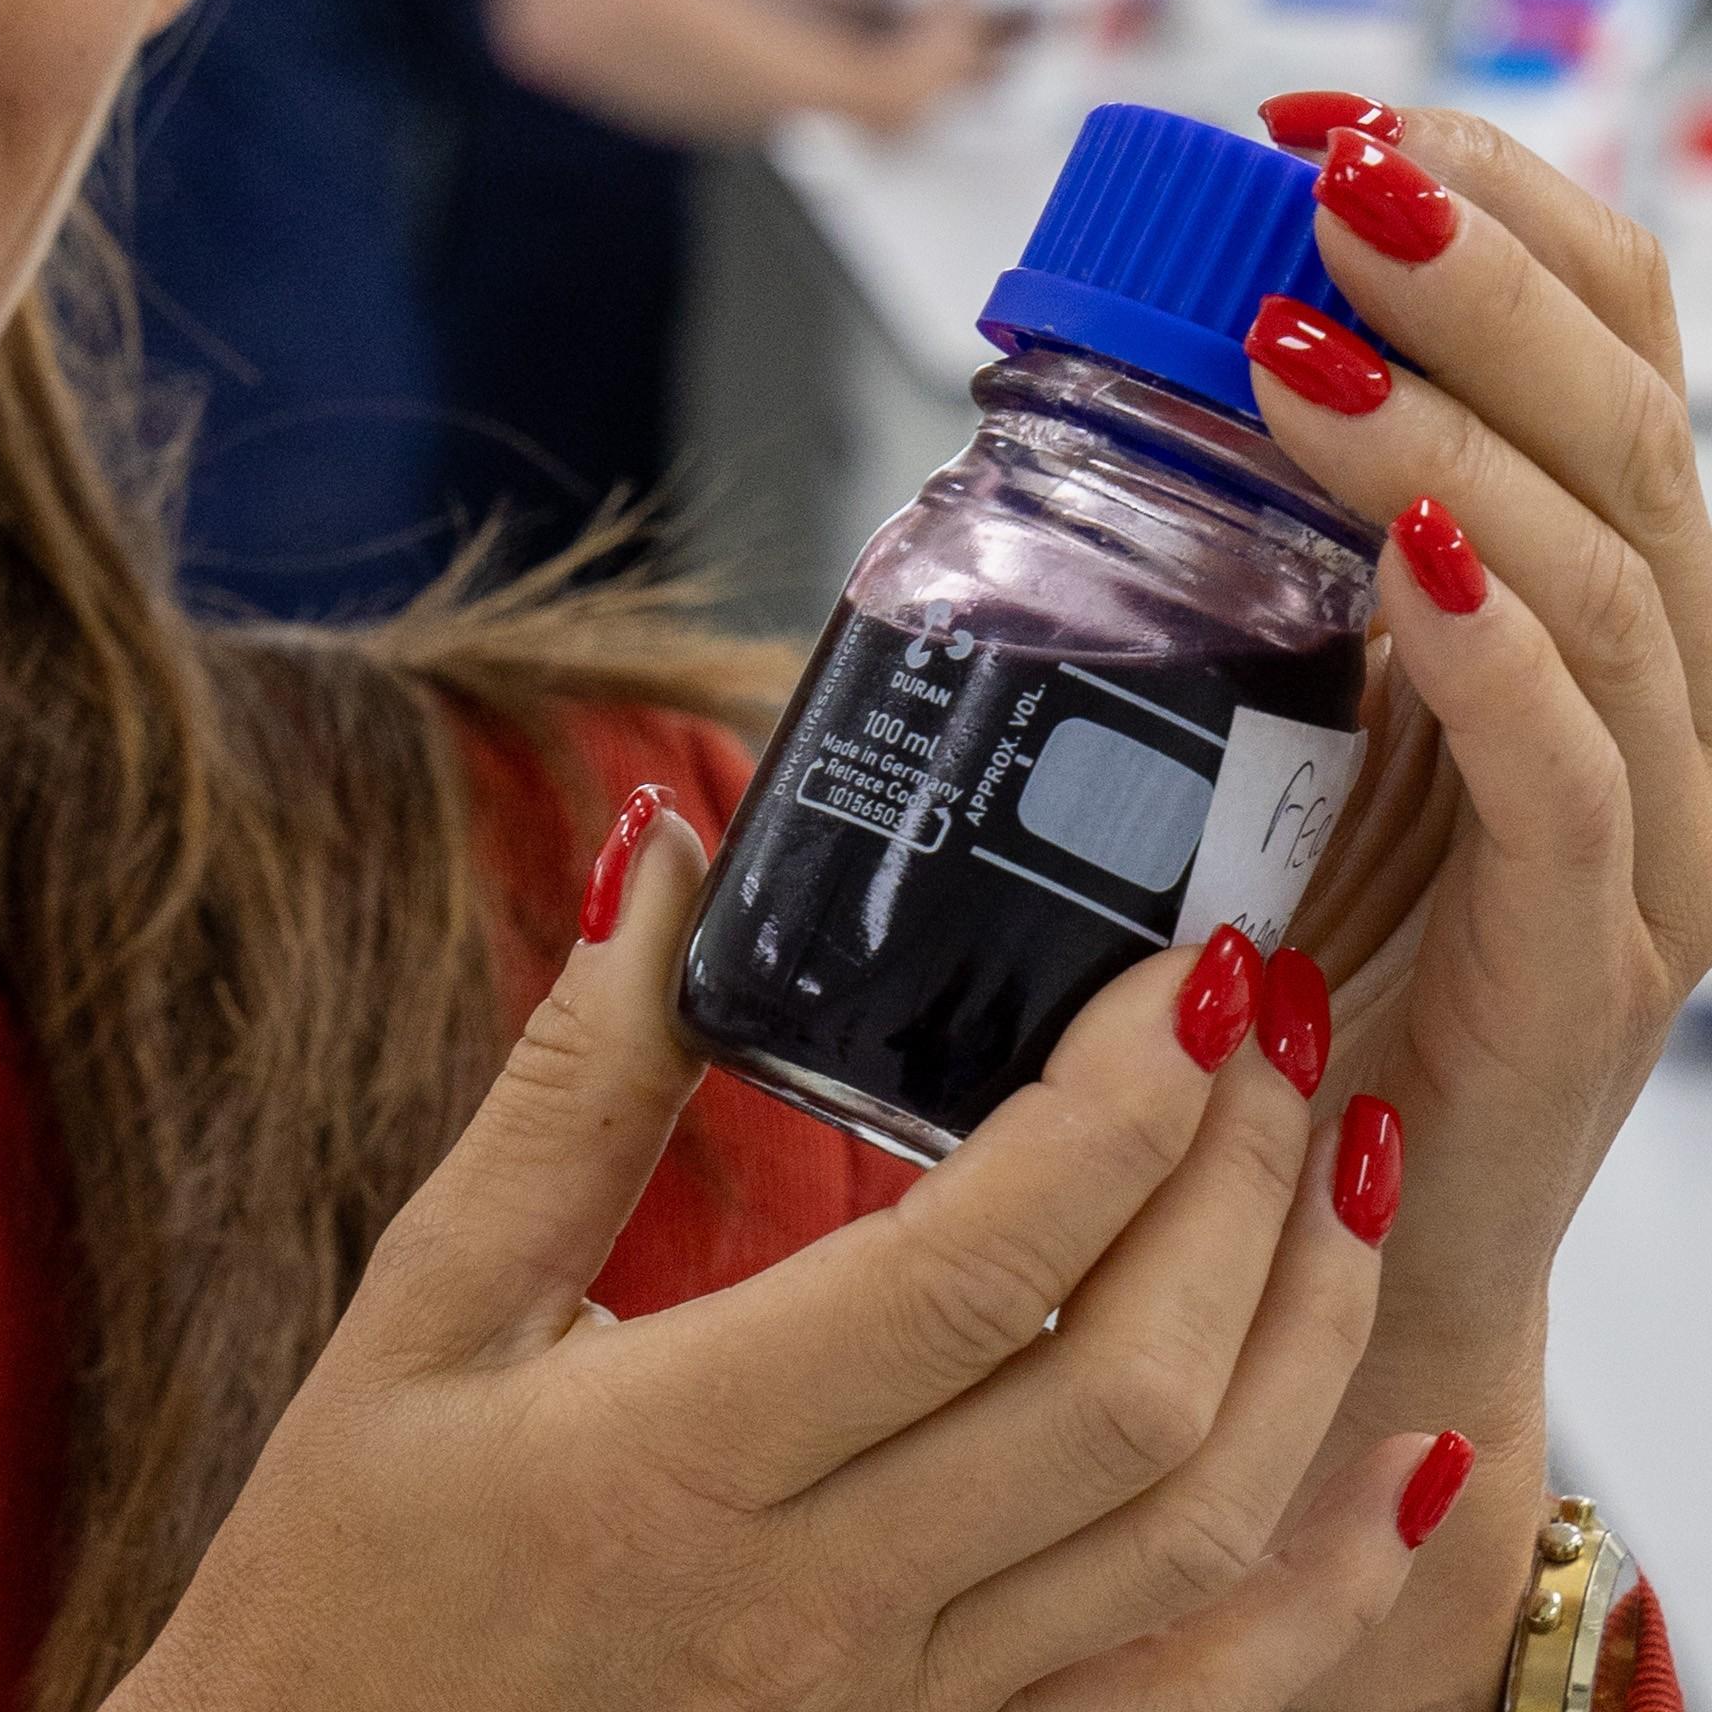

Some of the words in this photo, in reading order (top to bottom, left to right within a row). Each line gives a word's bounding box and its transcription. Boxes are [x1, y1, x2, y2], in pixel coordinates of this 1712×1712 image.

[890, 670, 953, 708] DURAN
[863, 709, 905, 744] 100
[902, 731, 941, 760] ml
[964, 736, 1021, 827] APPROX.
[1008, 683, 1047, 727] VOL.
[820, 731, 860, 759] Made
[860, 745, 878, 766] in
[880, 753, 964, 804] Germany
[824, 757, 885, 794] Retrace
[886, 781, 932, 809] Code
